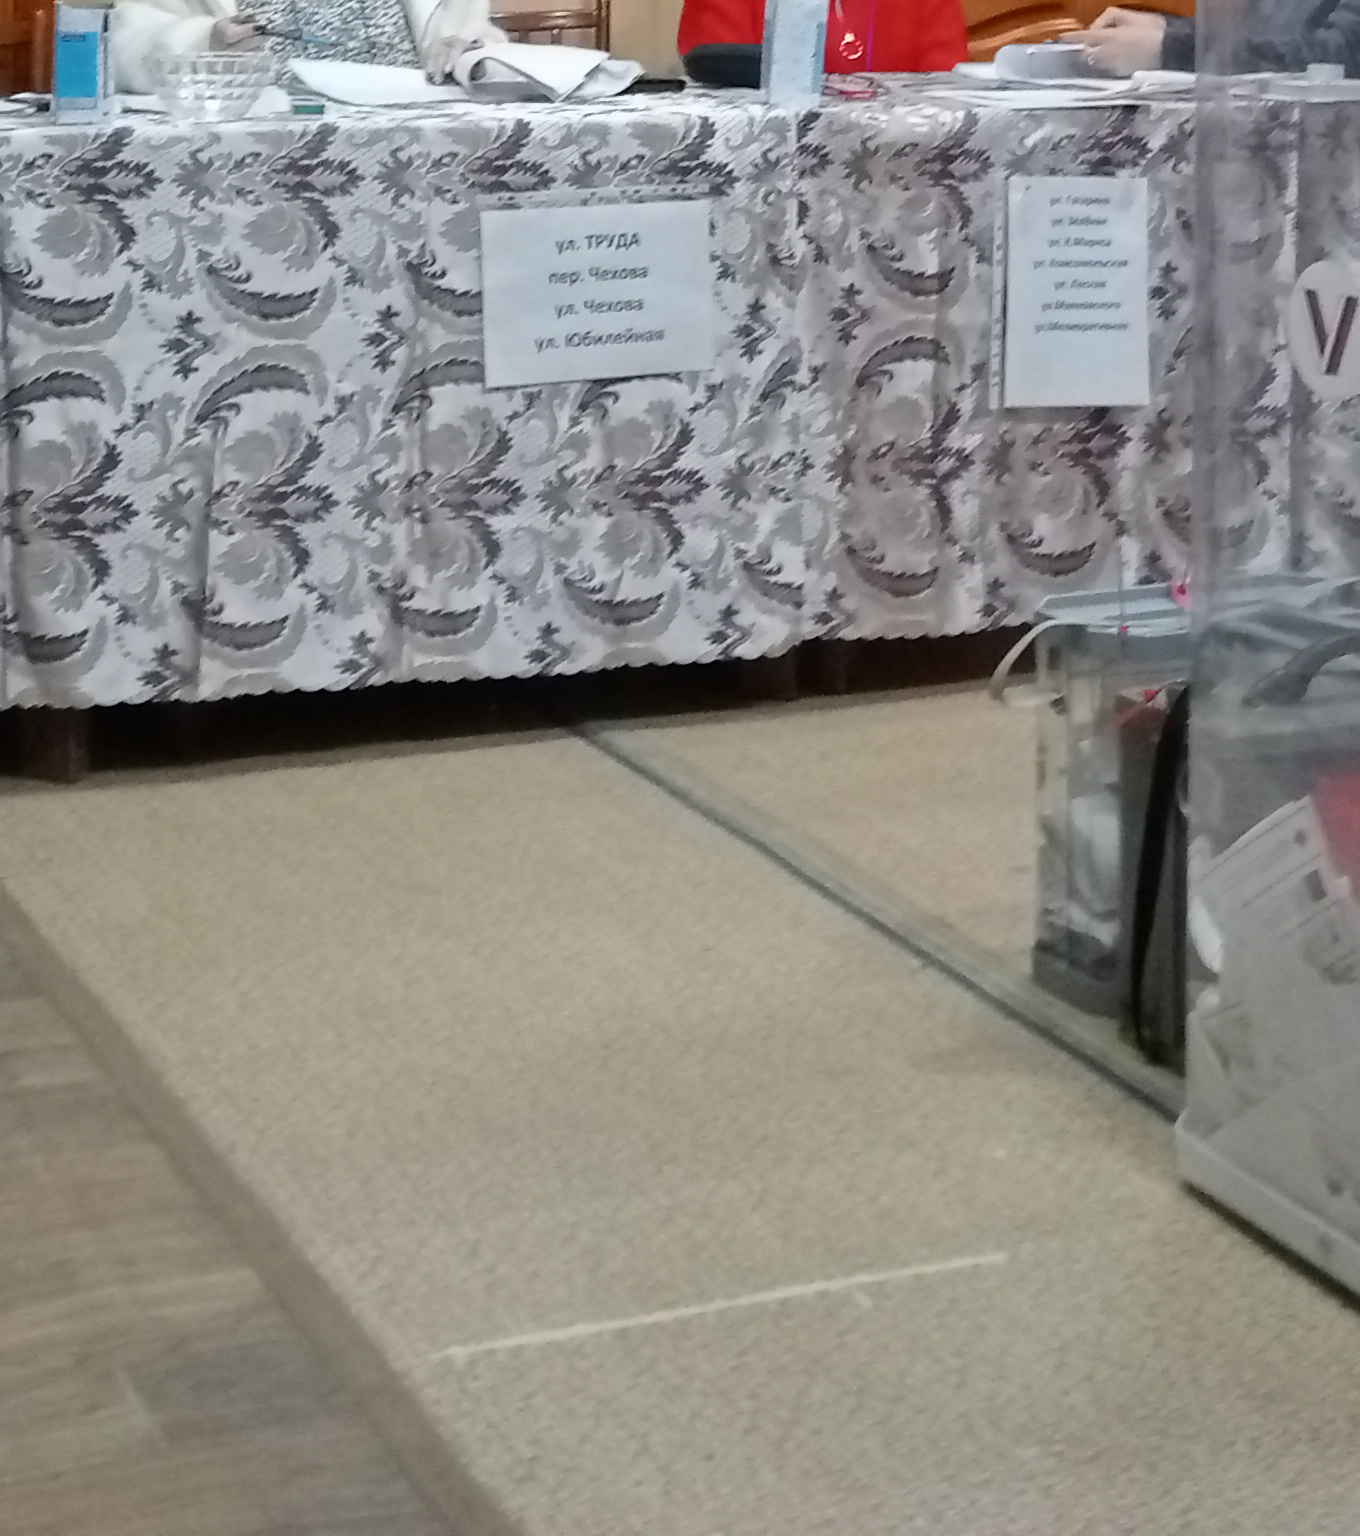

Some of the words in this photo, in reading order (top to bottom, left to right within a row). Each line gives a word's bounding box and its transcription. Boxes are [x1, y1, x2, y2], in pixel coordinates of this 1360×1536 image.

[555, 240, 579, 255] ул.
[584, 233, 639, 250] ТРУДА
[548, 271, 583, 286] пер.
[588, 266, 648, 281] Чехова
[554, 304, 578, 318] ул.
[583, 299, 643, 314] Чехова
[534, 337, 558, 352] ул.
[564, 328, 664, 348] Юбилейная
